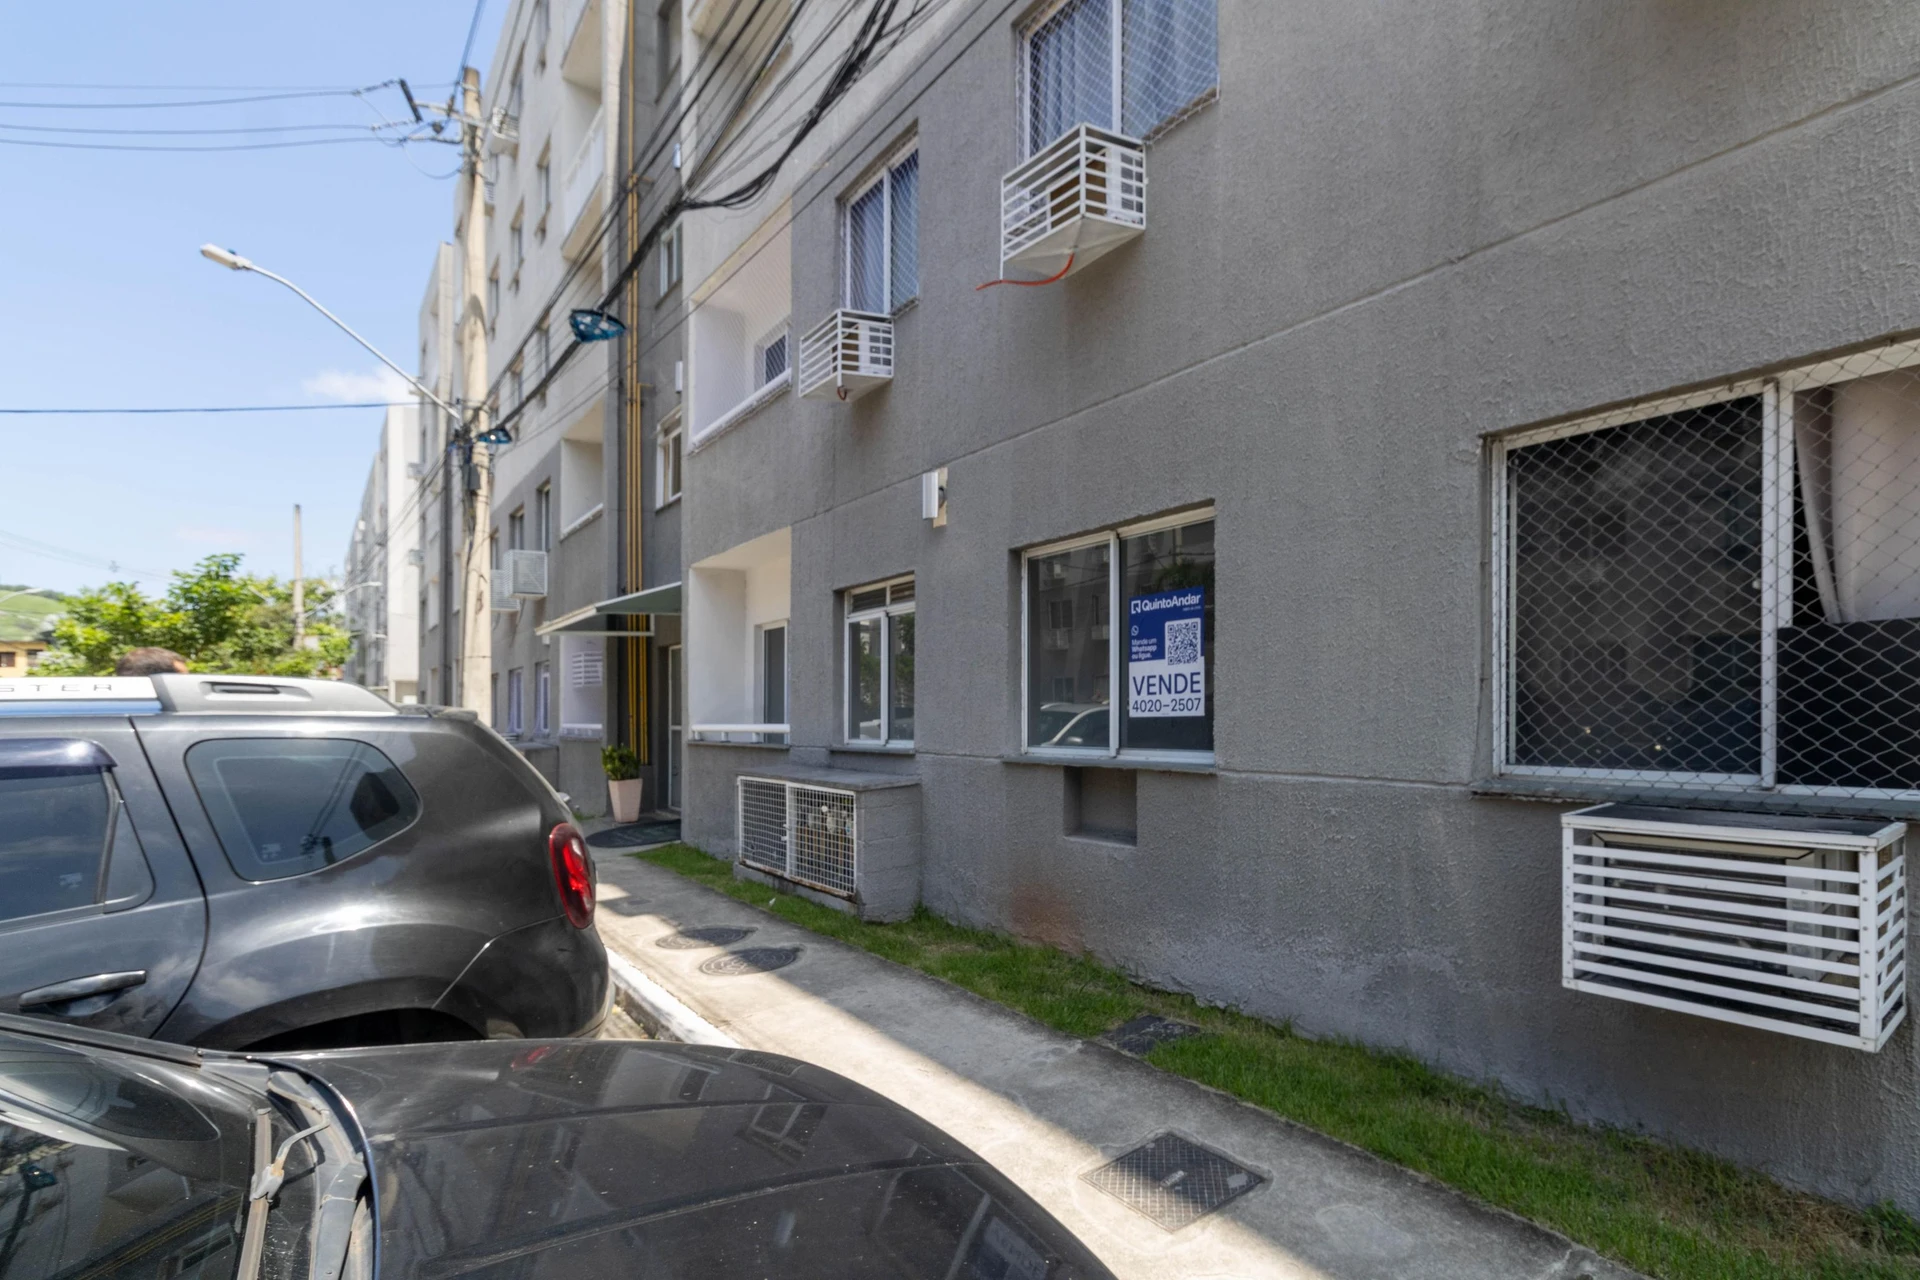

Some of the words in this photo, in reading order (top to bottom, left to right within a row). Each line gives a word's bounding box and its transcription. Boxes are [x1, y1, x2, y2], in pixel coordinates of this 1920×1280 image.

[1142, 593, 1201, 612] QuintoAndar
[1132, 672, 1201, 696] VENDE
[1132, 697, 1201, 713] 4020-2507
